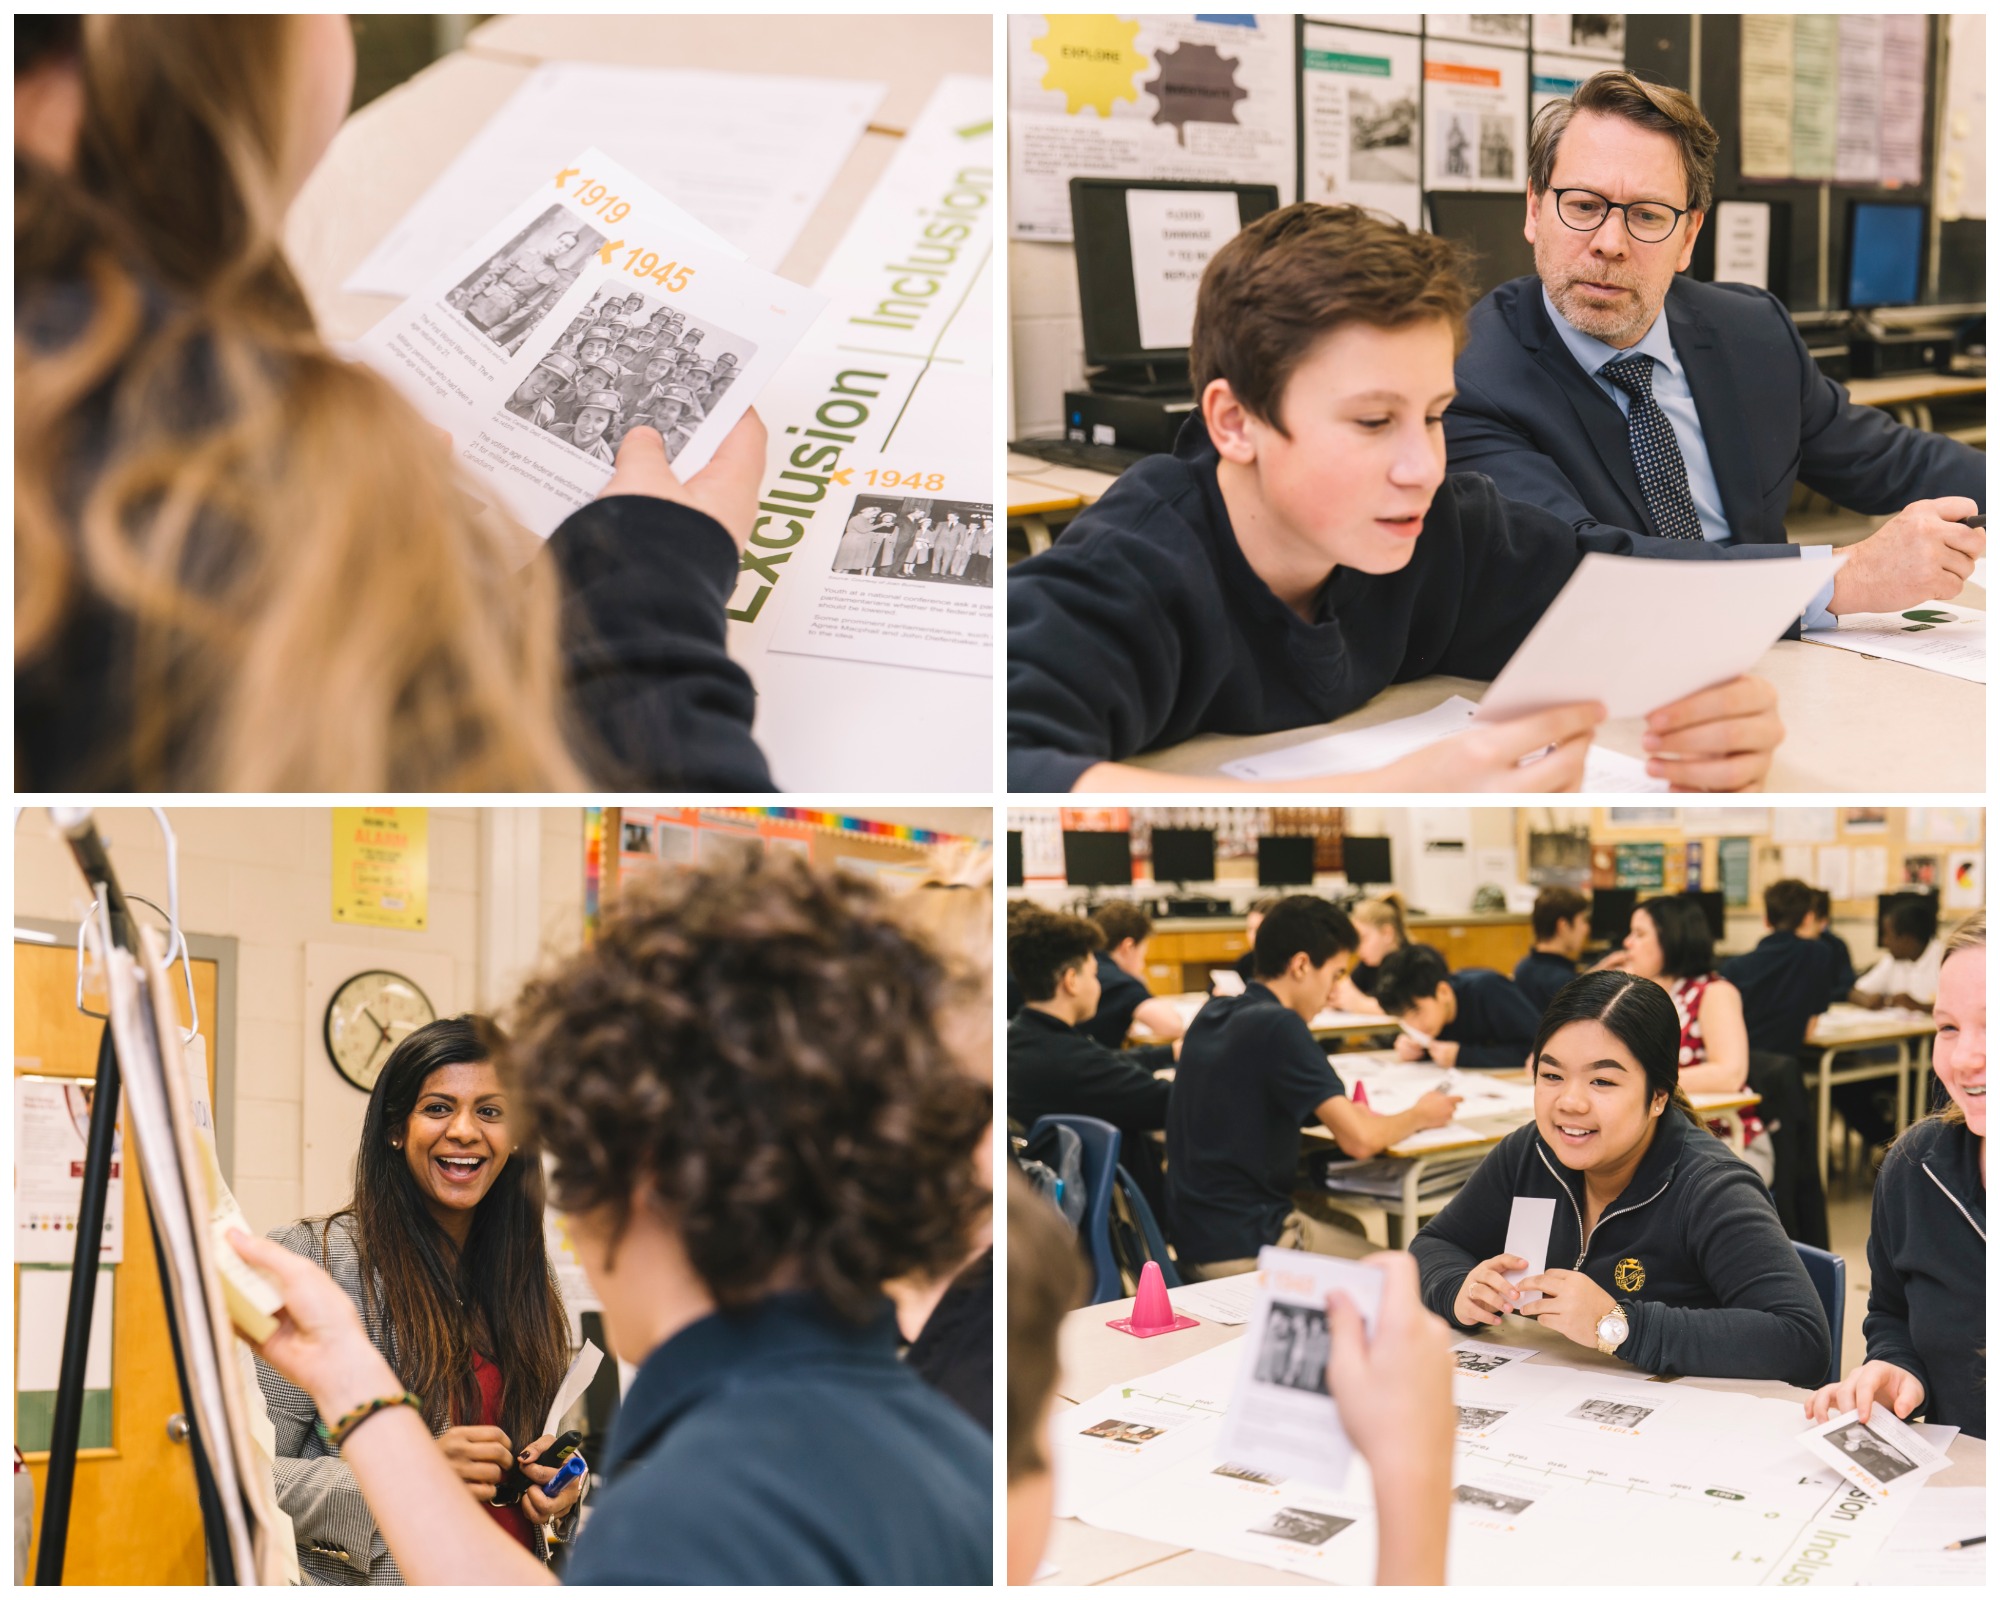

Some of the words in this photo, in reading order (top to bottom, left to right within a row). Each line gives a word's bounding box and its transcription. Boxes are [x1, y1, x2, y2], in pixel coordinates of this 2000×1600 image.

[1060, 45, 1121, 64] EXPLORE
[572, 178, 631, 224] 1919
[849, 165, 993, 331] Inclusion
[623, 247, 695, 293] 1945
[478, 365, 489, 377] The
[476, 444, 489, 455] for
[486, 450, 511, 468] military
[542, 481, 555, 493] the
[553, 488, 574, 503] same
[478, 431, 492, 443] The
[490, 438, 511, 454] voting
[509, 448, 523, 460] age
[522, 455, 533, 465] for
[531, 461, 556, 478] federal
[553, 474, 584, 494] elections
[864, 468, 946, 492] 1948
[728, 367, 890, 624] Exclusion
[818, 602, 847, 611] should
[848, 604, 860, 612] be
[820, 595, 891, 608] parliamentarians
[893, 601, 928, 612] whether
[930, 604, 944, 613] the
[946, 607, 977, 616] federal
[824, 587, 847, 595] Youth
[867, 591, 902, 600] national
[903, 594, 952, 606] conference
[954, 600, 969, 608] ask
[811, 622, 838, 632] Agnes
[882, 629, 899, 637] and
[900, 631, 923, 640] John
[814, 614, 839, 623] Some
[841, 618, 886, 628] prominent
[967, 631, 990, 639] such
[819, 629, 833, 637] the
